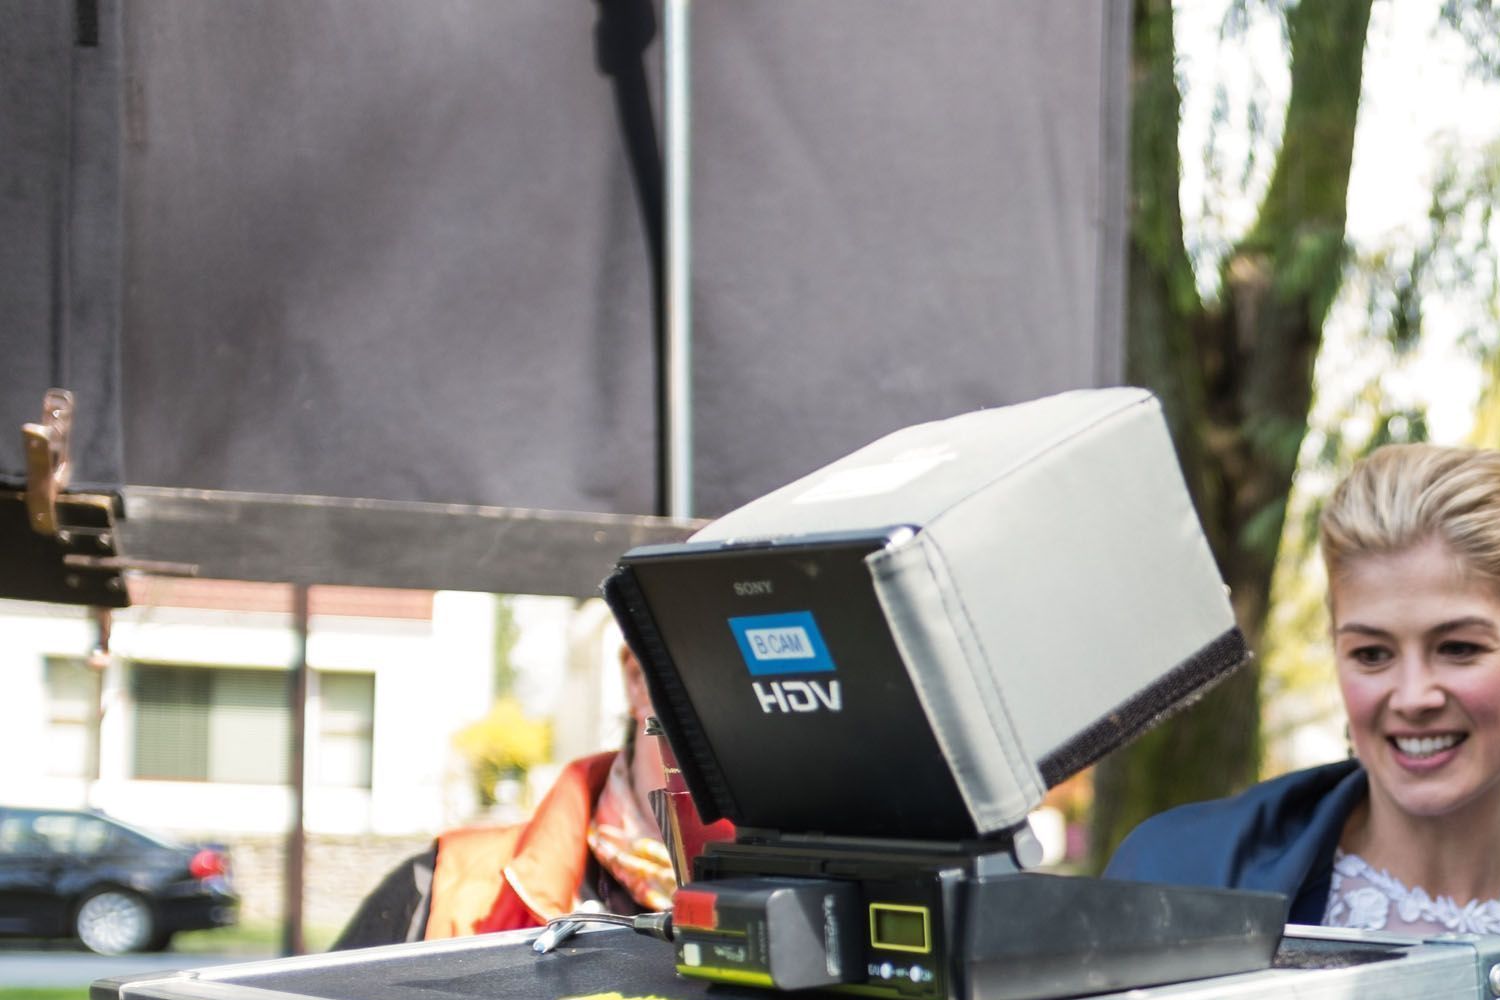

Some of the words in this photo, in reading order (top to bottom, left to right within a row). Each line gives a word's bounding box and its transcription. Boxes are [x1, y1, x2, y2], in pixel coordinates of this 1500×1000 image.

[733, 581, 774, 596] SONY
[753, 634, 768, 655] B
[768, 633, 804, 653] CAM
[751, 680, 843, 714] HDV
